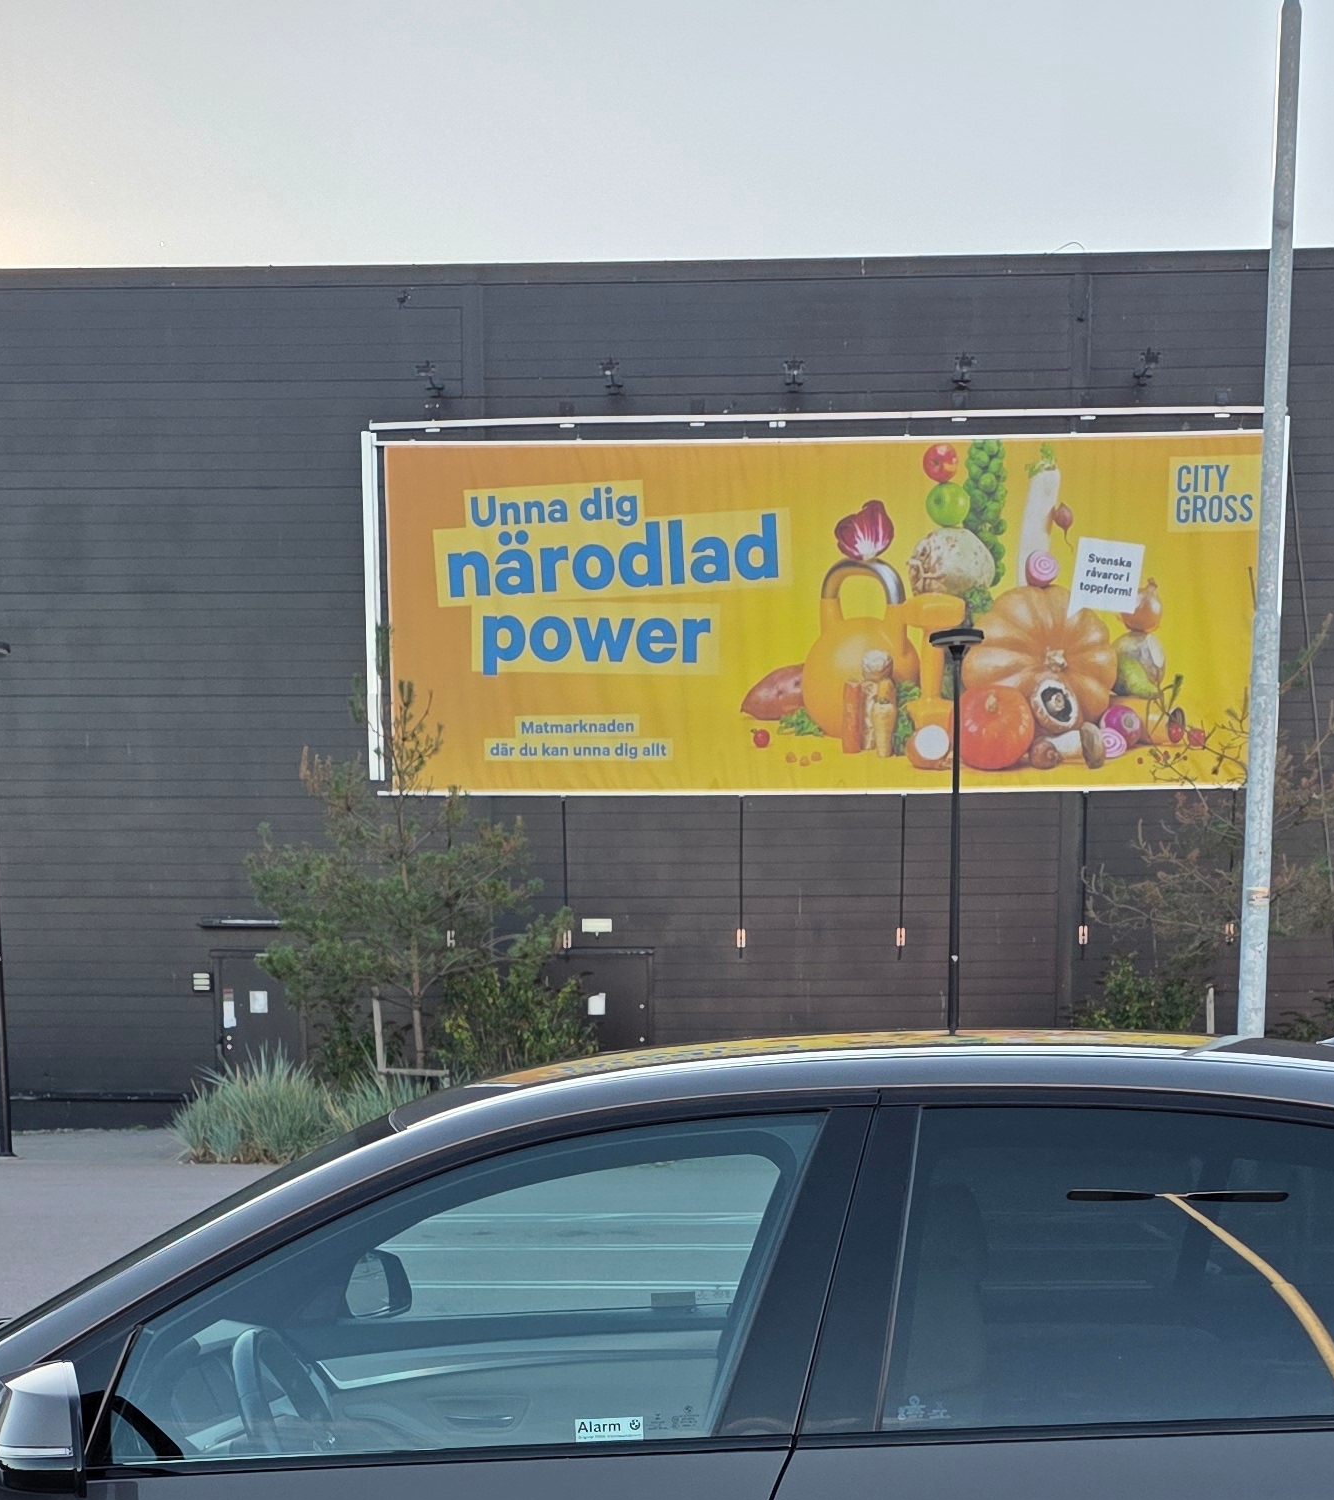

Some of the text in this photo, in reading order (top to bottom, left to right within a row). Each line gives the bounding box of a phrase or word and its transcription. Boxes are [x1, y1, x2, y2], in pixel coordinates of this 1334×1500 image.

[1176, 464, 1230, 494] CITY
[470, 486, 638, 528] Unna dig
[1175, 493, 1253, 524] GROSS
[447, 512, 780, 598] närodlad
[1087, 553, 1132, 568] Svenska
[1085, 566, 1131, 583] råvaror i
[1079, 581, 1133, 597] toppform!
[482, 614, 711, 676] power
[520, 719, 635, 735] Matmarknaden
[489, 742, 667, 759] där du kan unna dig allt
[577, 1421, 621, 1434] Alarm
